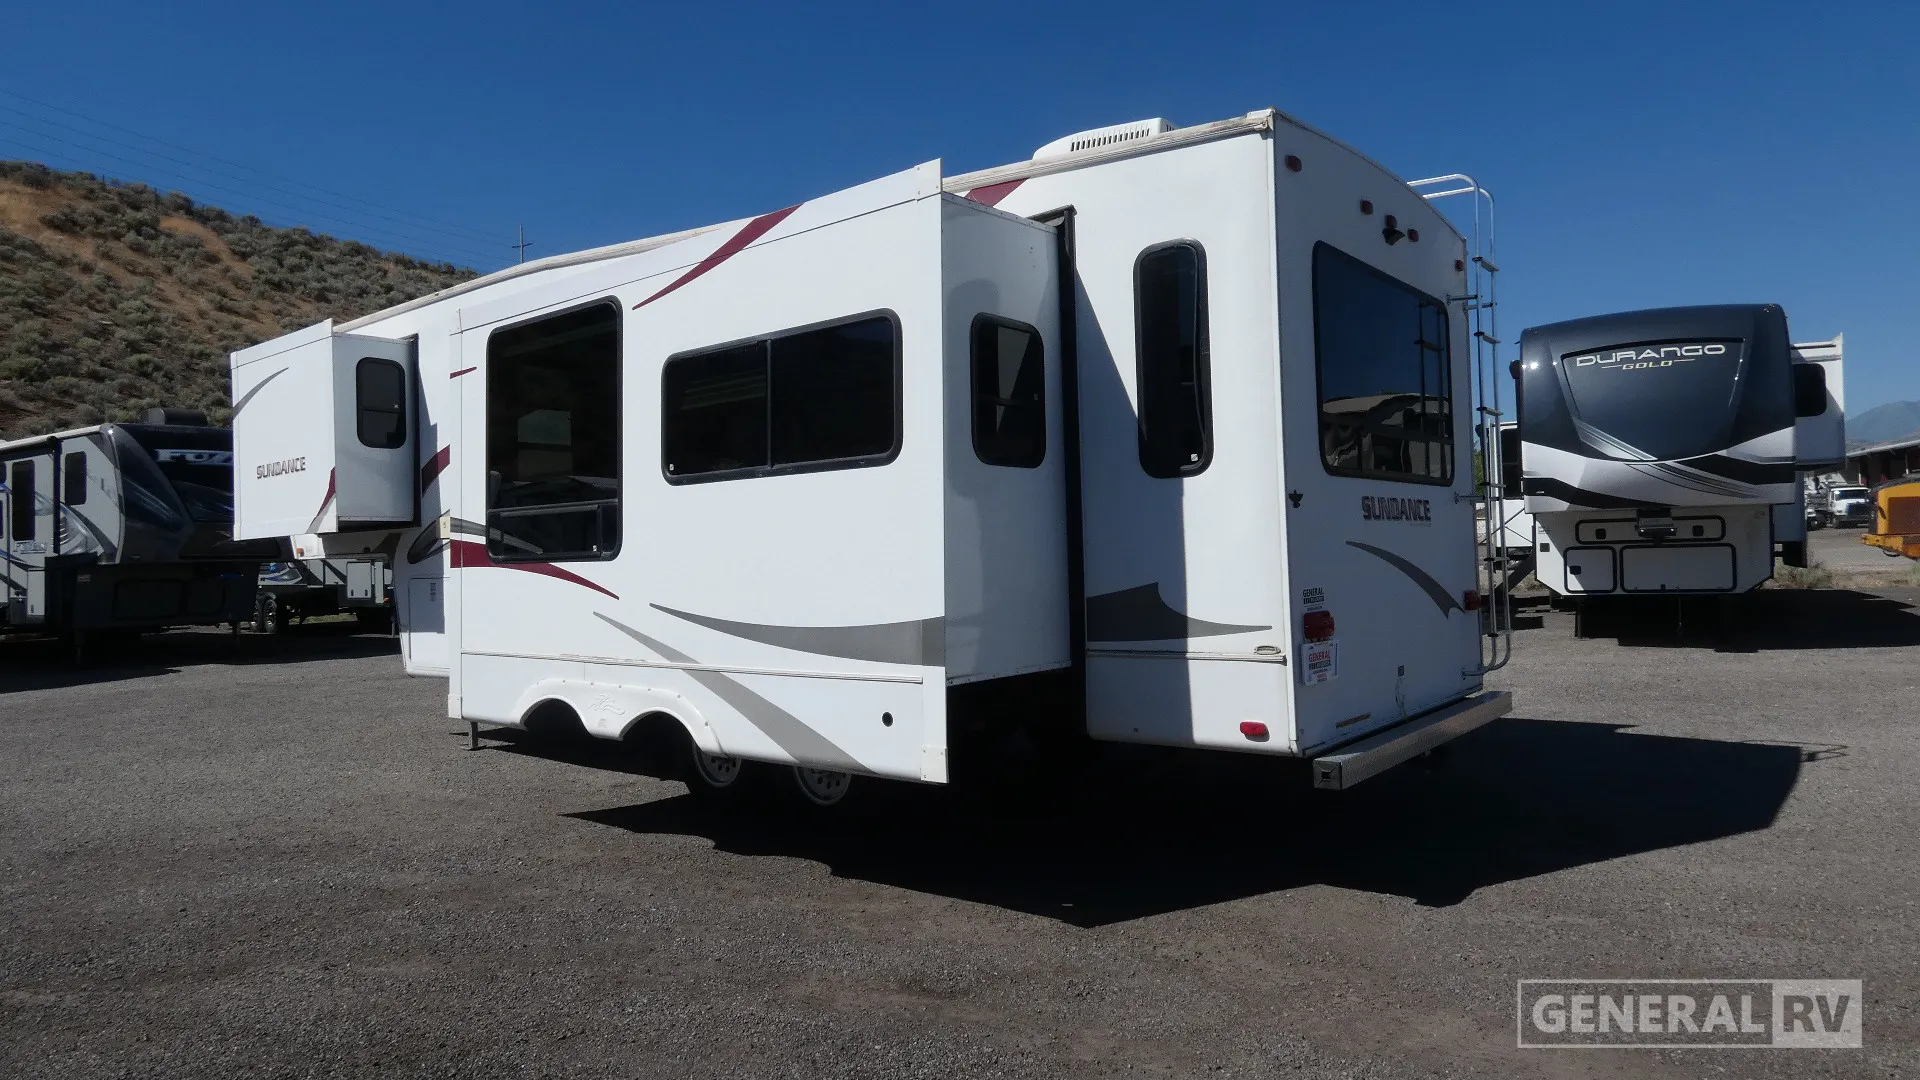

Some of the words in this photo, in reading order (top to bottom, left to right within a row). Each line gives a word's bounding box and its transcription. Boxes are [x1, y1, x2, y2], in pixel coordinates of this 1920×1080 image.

[1576, 344, 1726, 367] DURANGO
[1622, 360, 1673, 370] GOLD
[256, 456, 306, 480] SUNDANCE
[1361, 495, 1432, 521] SUNDANCE
[1302, 587, 1325, 598] GENERAL
